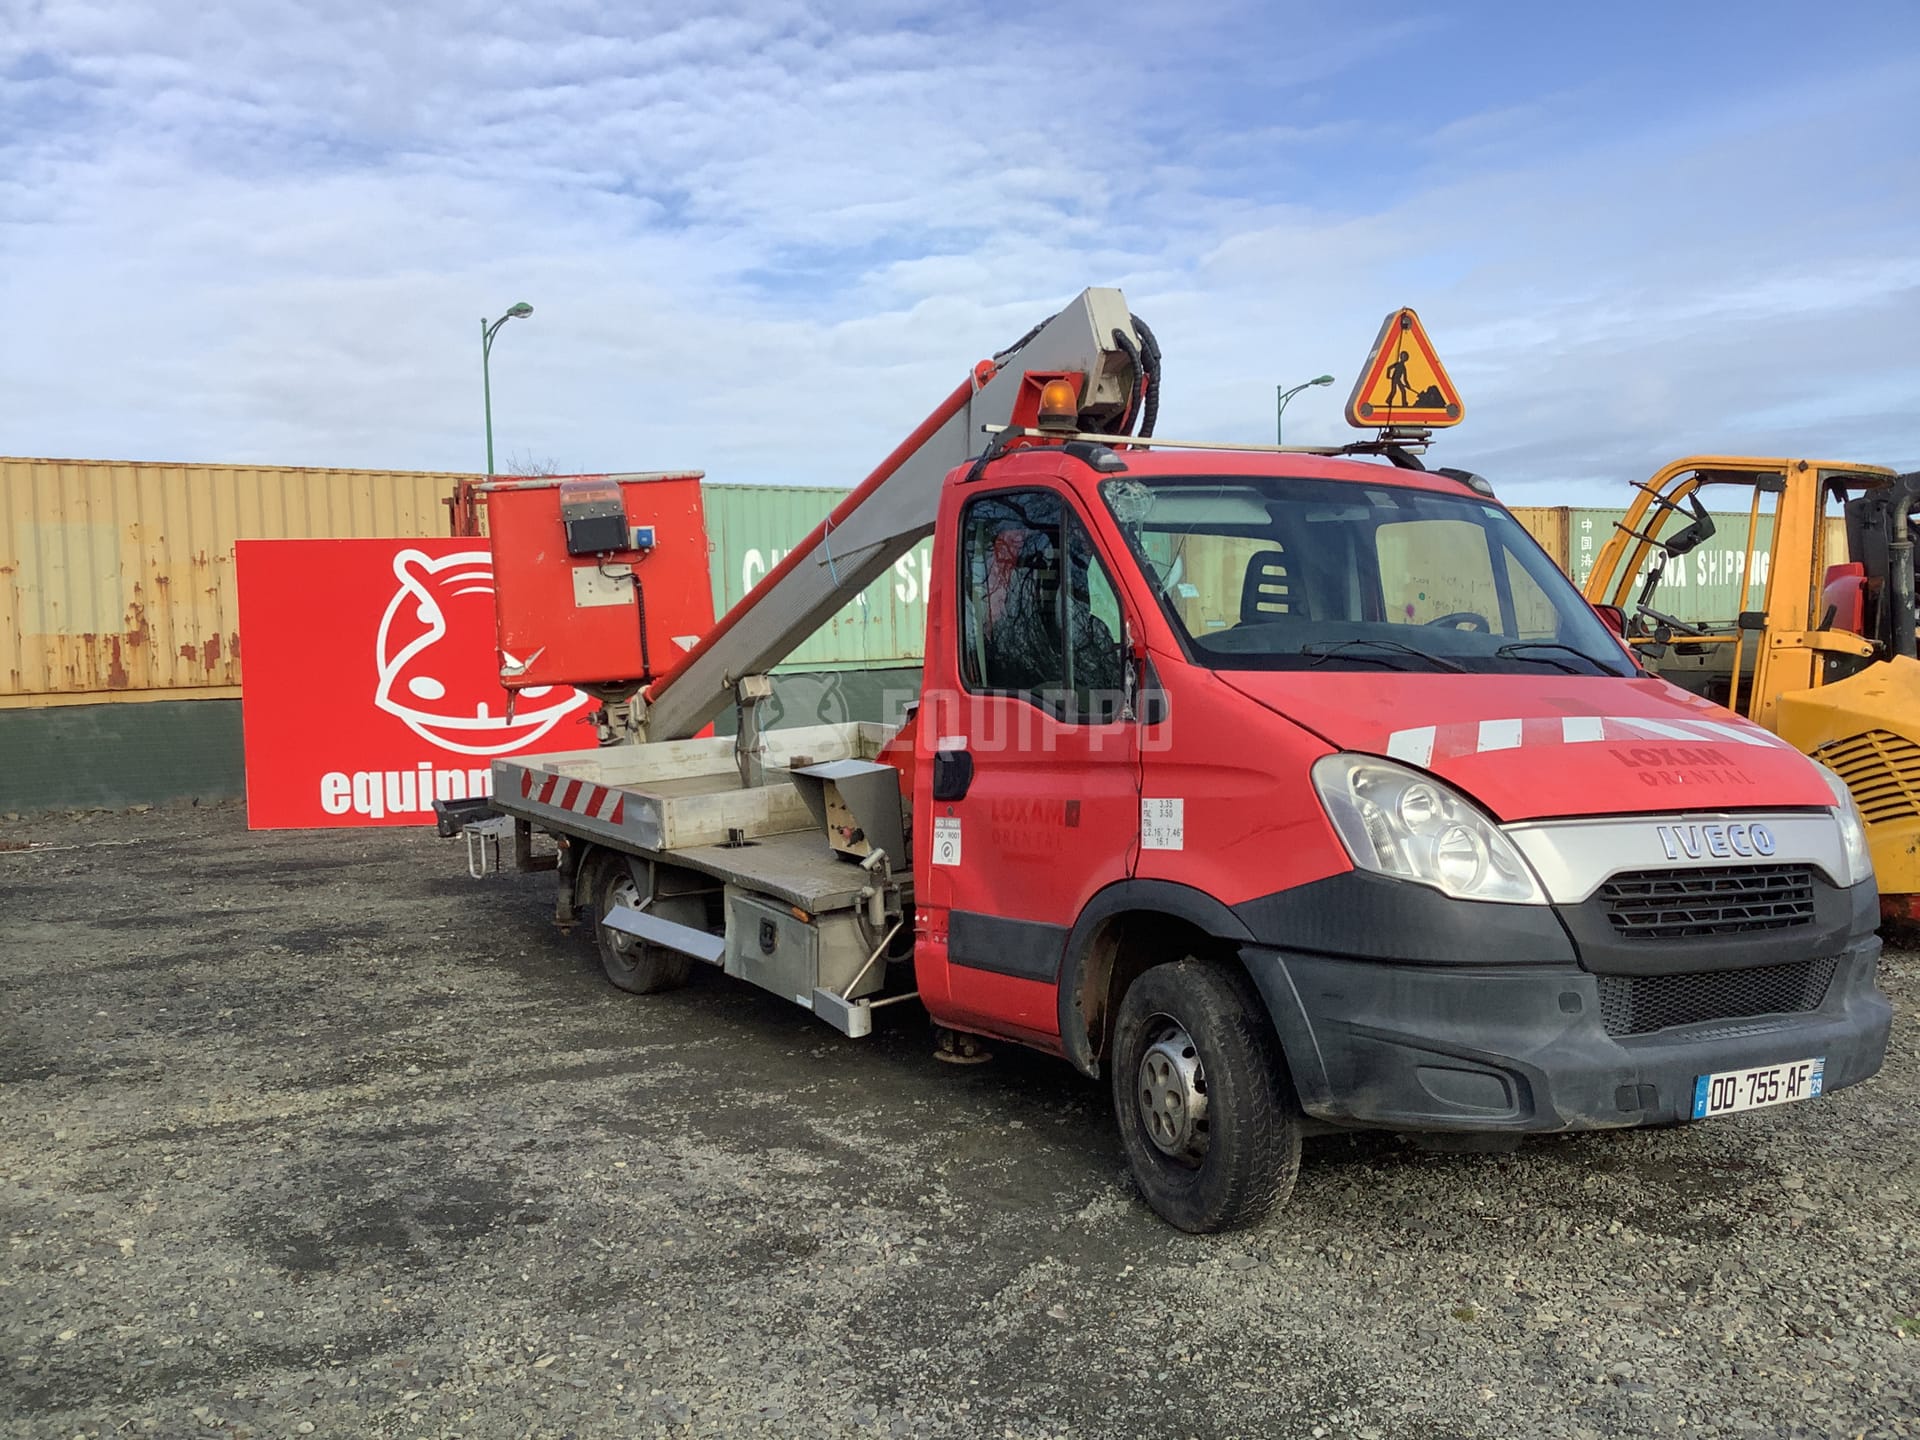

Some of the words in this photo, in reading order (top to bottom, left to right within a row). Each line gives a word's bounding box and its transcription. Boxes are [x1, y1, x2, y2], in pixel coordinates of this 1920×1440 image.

[1697, 550, 1770, 586] SHIPPNG
[1609, 749, 1736, 768] LOXAM
[992, 798, 1064, 826] LOXAM
[1656, 823, 1777, 860] IVECO
[1811, 1078, 1822, 1094] 29
[1697, 1100, 1704, 1111] F
